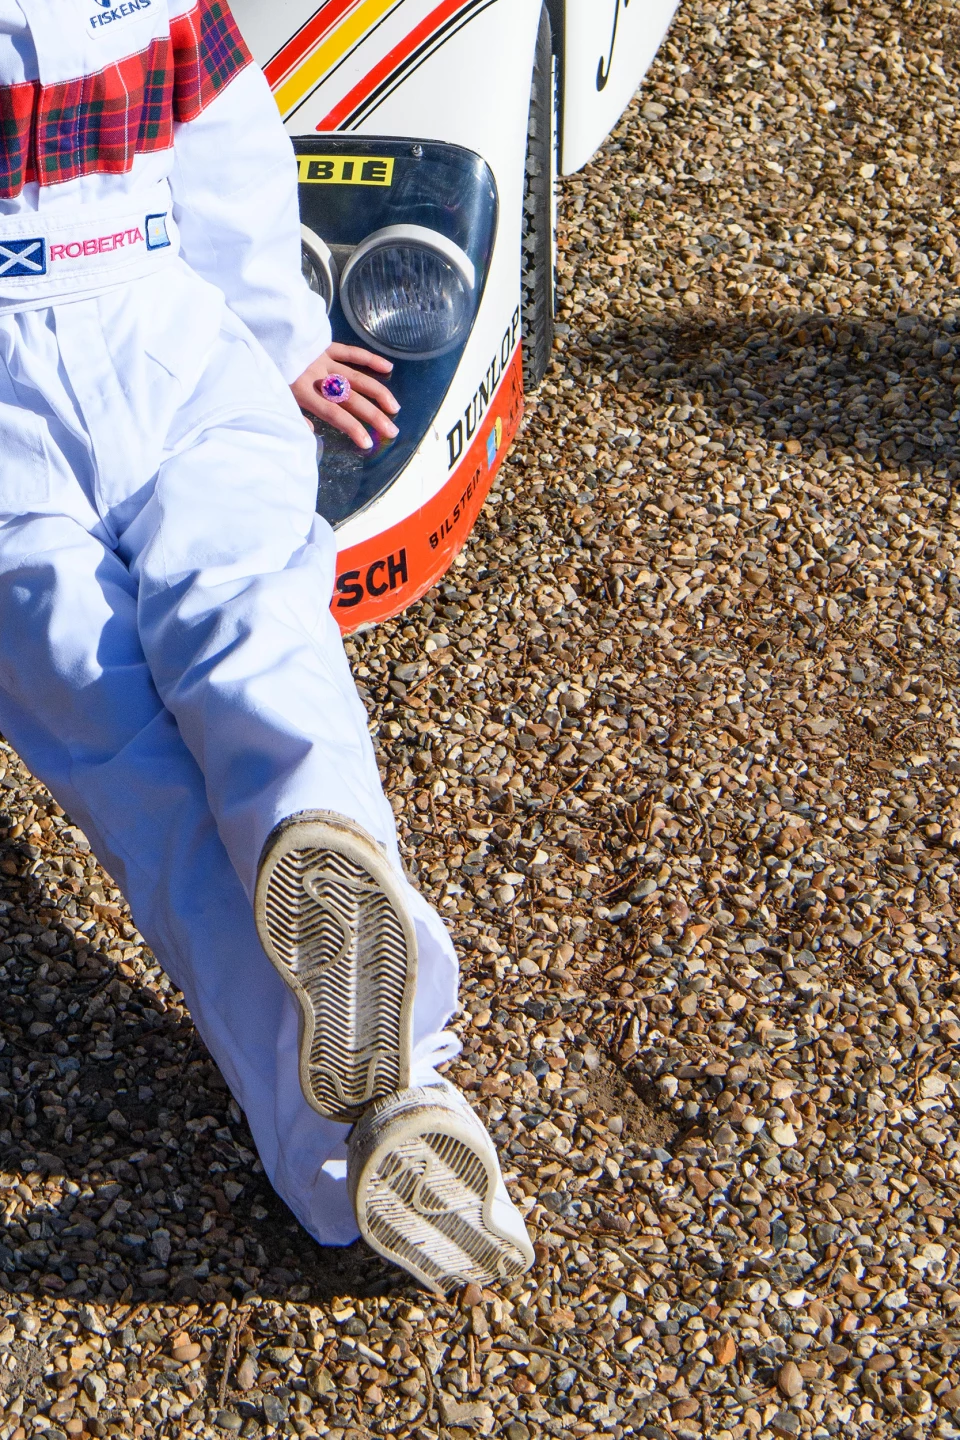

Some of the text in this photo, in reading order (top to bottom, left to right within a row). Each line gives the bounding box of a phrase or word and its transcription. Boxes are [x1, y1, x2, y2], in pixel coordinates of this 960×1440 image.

[297, 160, 388, 182] BIÉ
[49, 227, 145, 262] ROBERTA
[446, 304, 521, 471] DUNLOP
[330, 547, 409, 609] SCH
